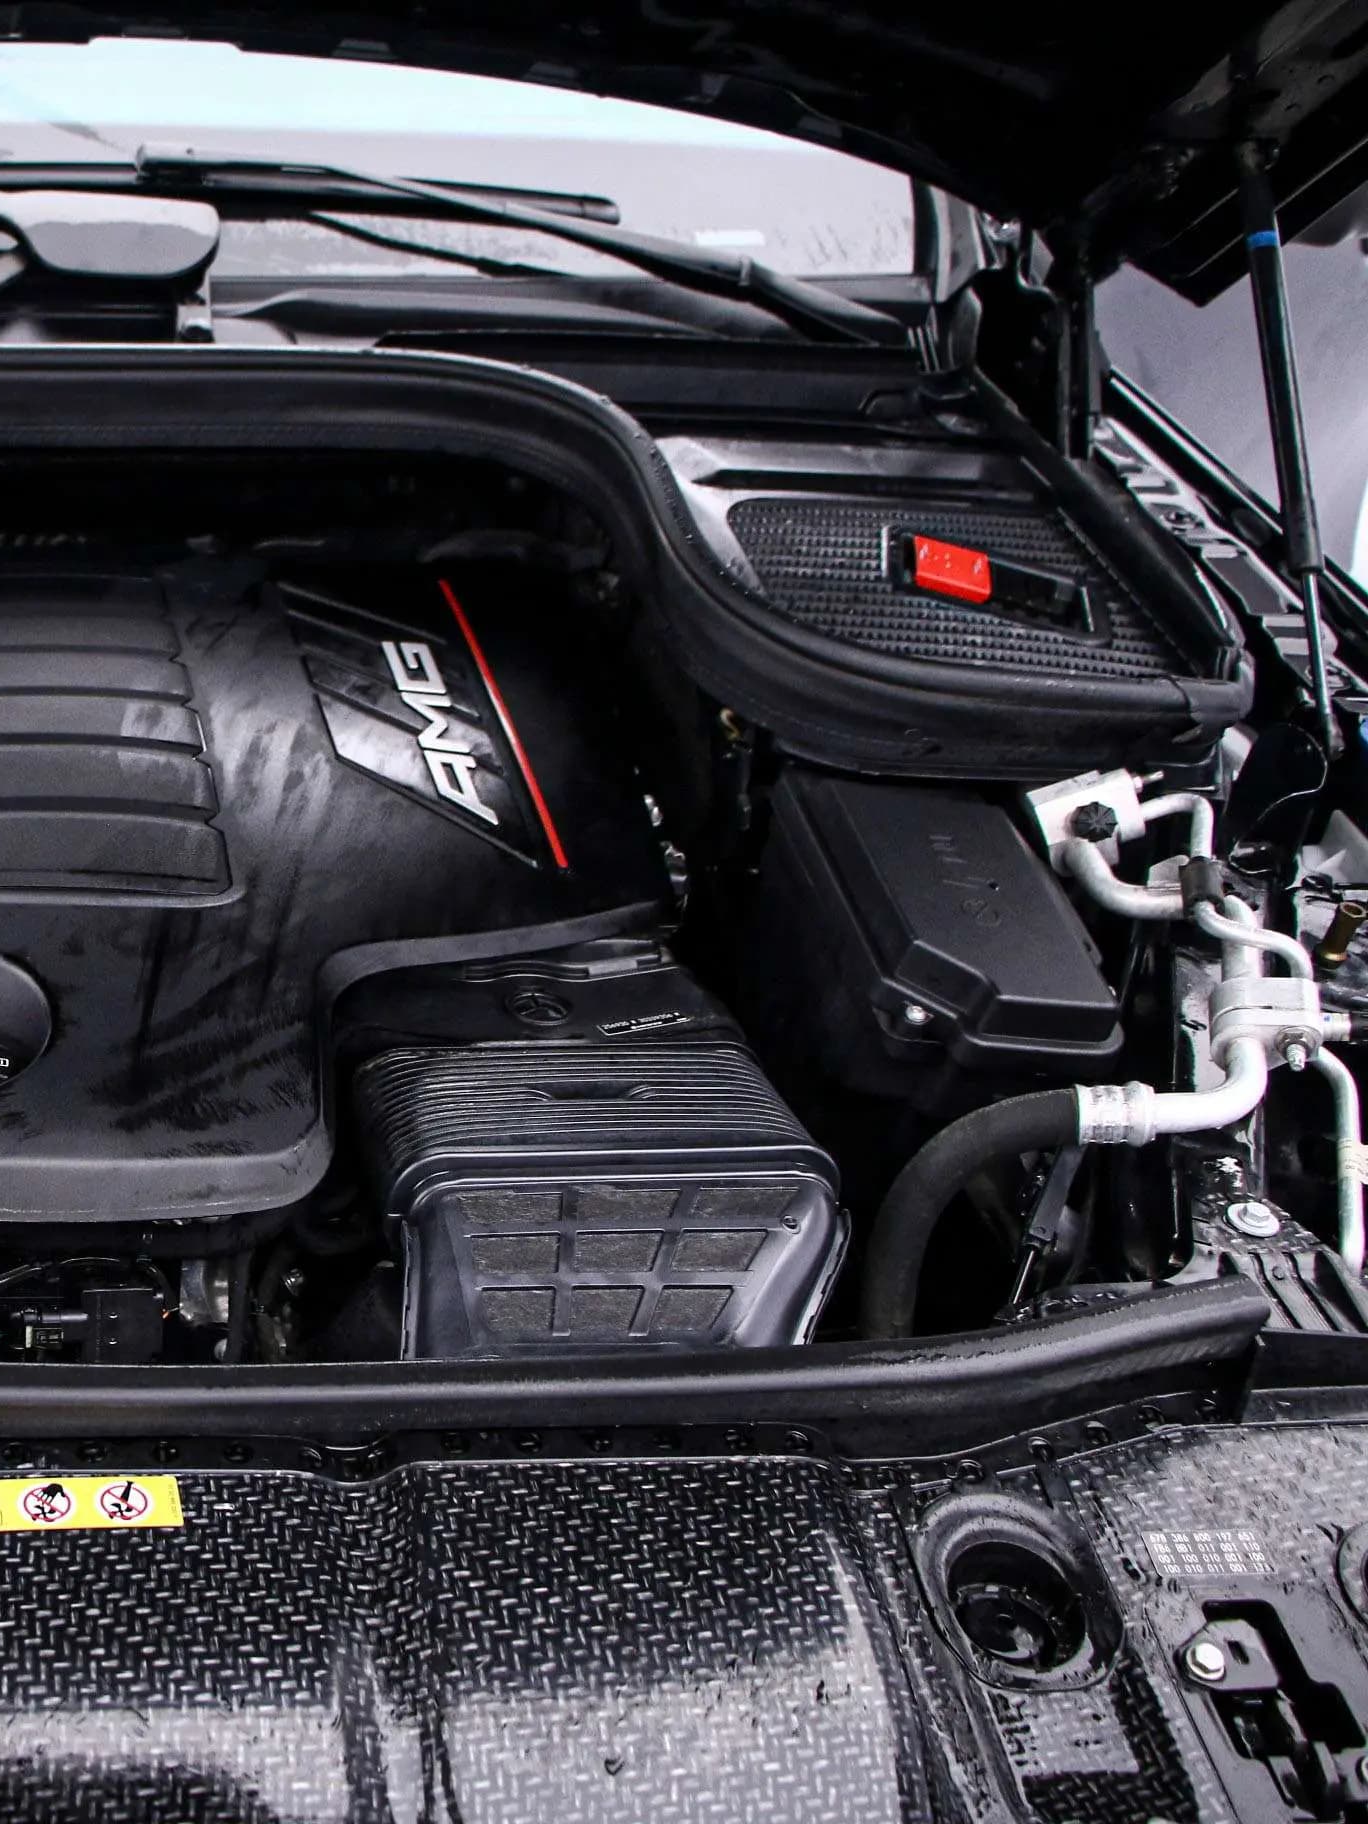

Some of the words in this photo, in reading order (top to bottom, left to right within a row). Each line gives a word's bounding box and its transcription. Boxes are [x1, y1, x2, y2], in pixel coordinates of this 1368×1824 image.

[381, 641, 499, 826] AMG
[1198, 1543, 1215, 1552] 011
[1220, 1543, 1238, 1552] 001
[1158, 1554, 1175, 1563] 001
[1181, 1554, 1198, 1563] 100
[1203, 1553, 1220, 1563] 010
[1248, 1552, 1265, 1562] 100
[1163, 1564, 1181, 1574] 100
[1185, 1564, 1202, 1573] 010
[1207, 1564, 1225, 1573] 011
